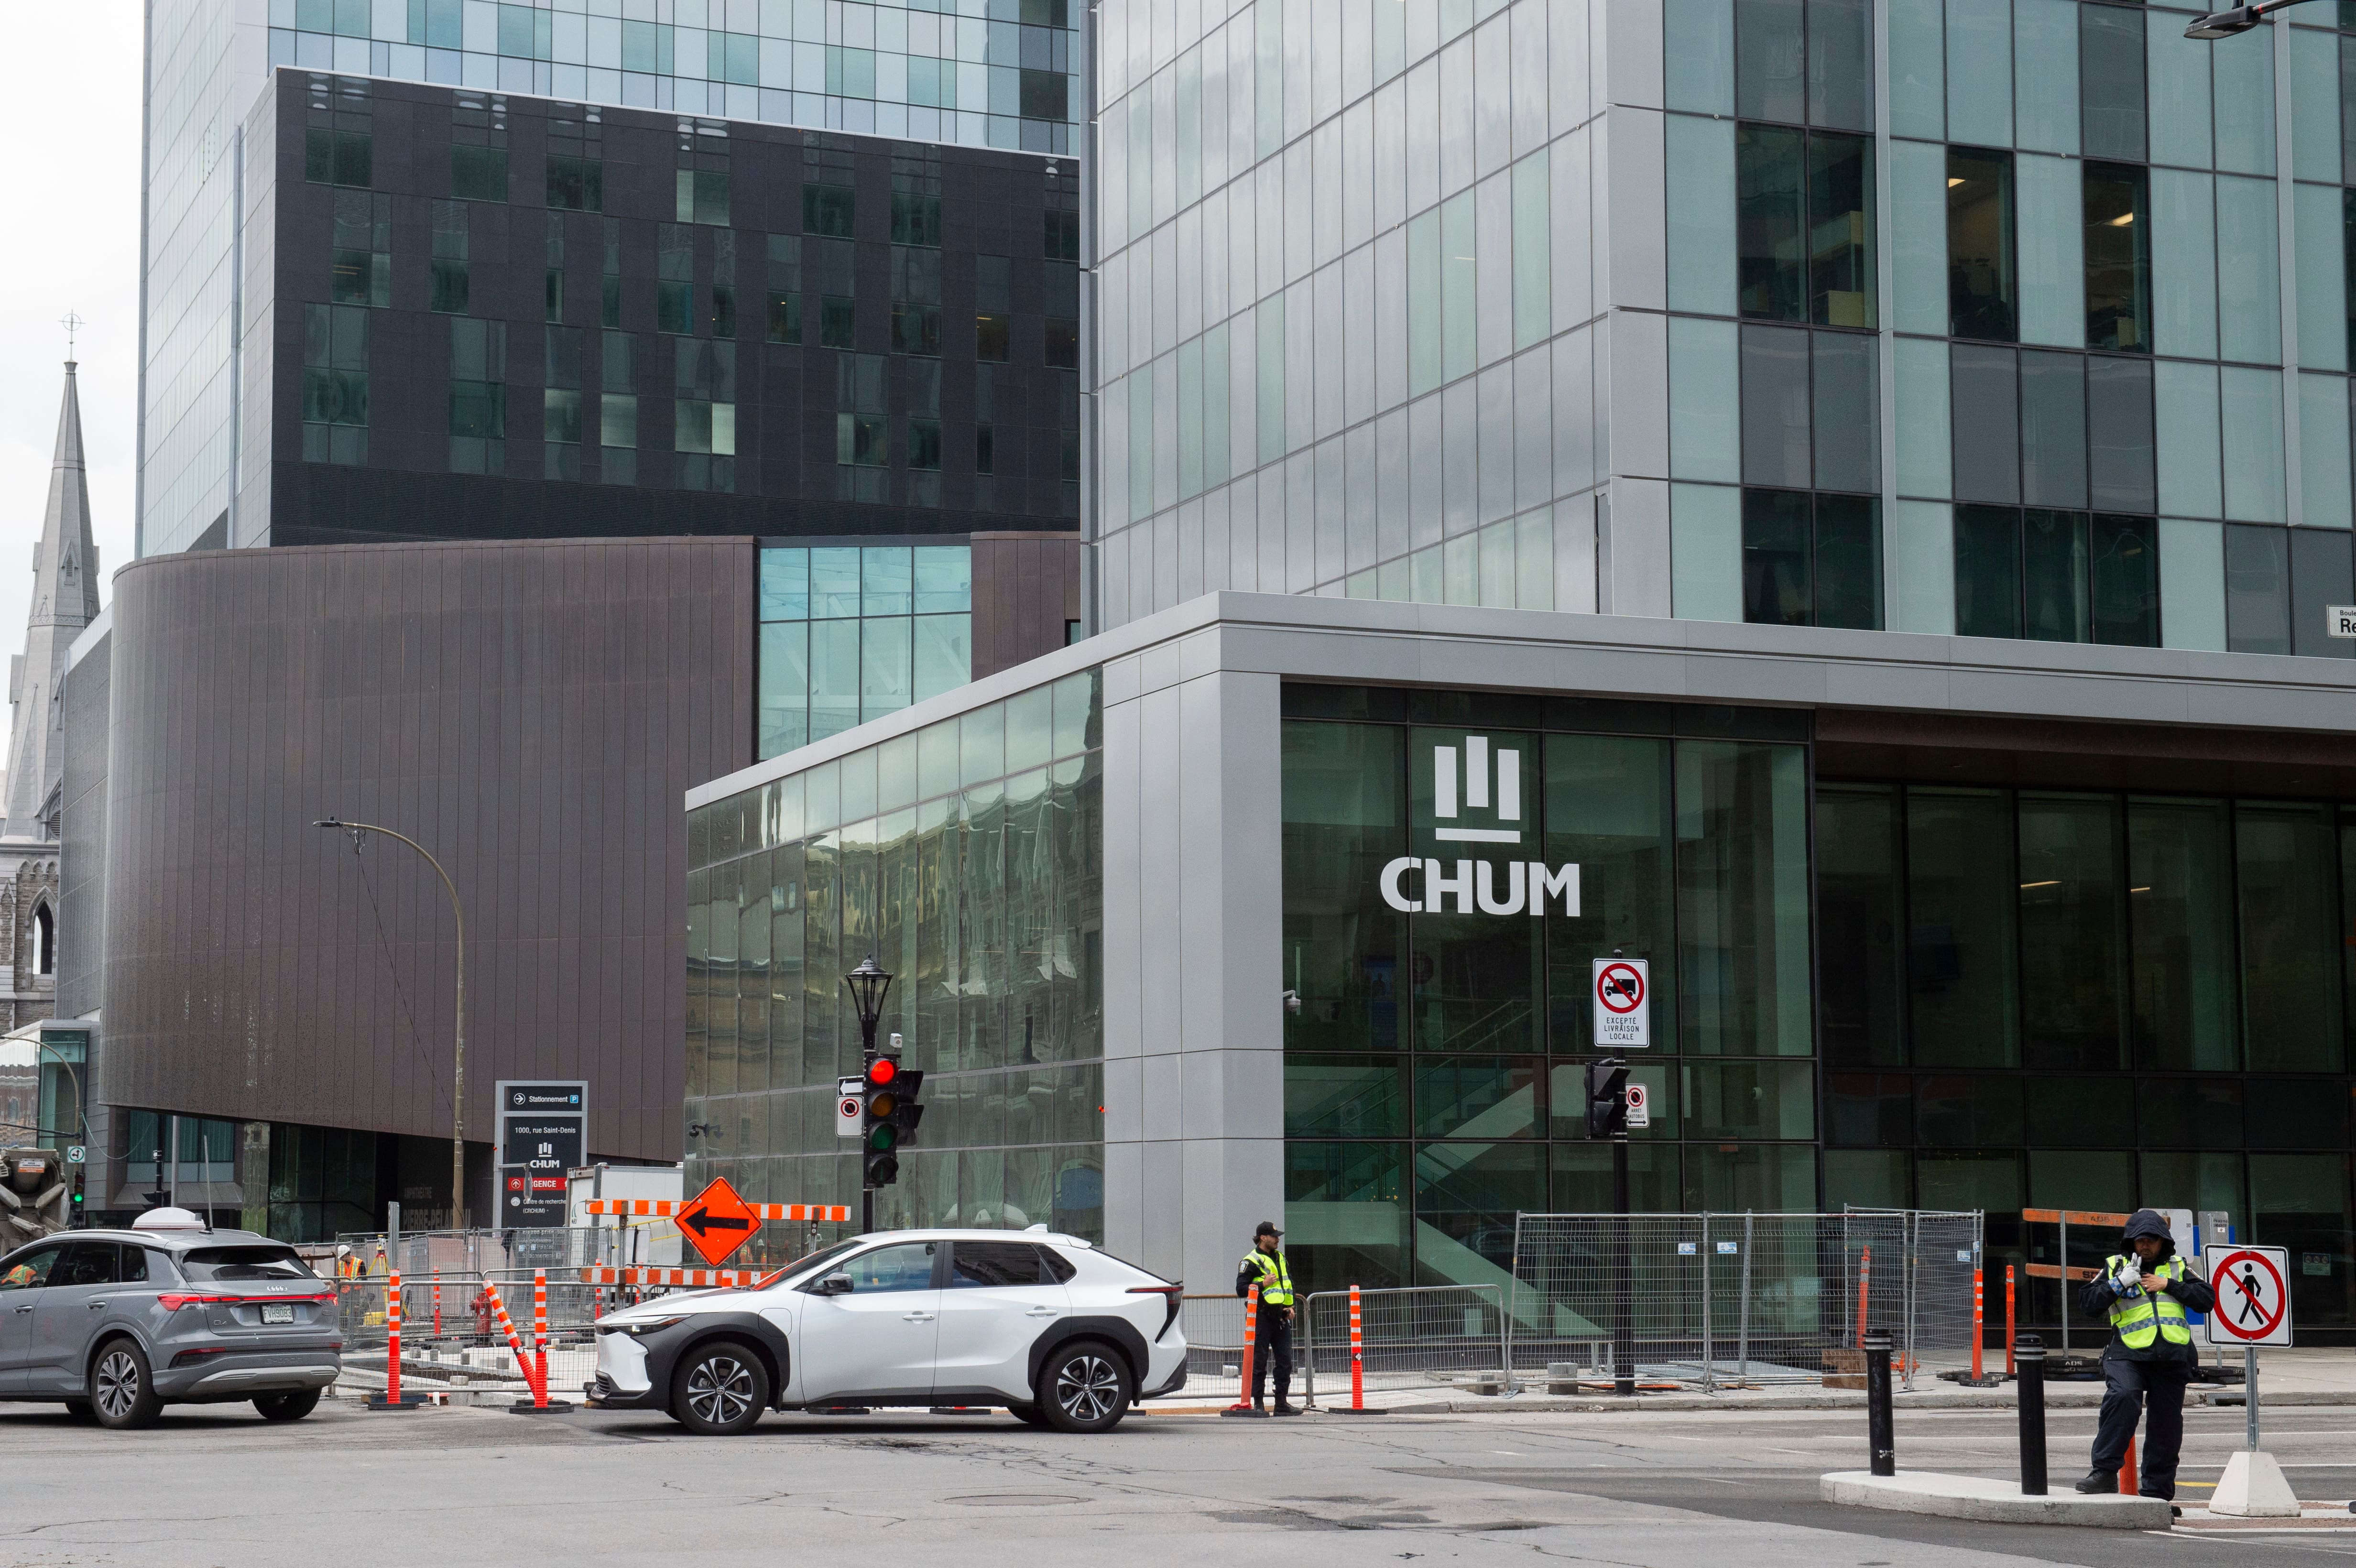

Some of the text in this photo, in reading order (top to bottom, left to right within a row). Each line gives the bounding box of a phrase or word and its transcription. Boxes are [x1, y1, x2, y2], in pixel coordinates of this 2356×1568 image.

[1380, 857, 1580, 917] CHUM
[1606, 1016, 1636, 1024] EXCEPTÉ
[530, 1160, 560, 1168] CHUM
[263, 1308, 292, 1319] FVH9083
